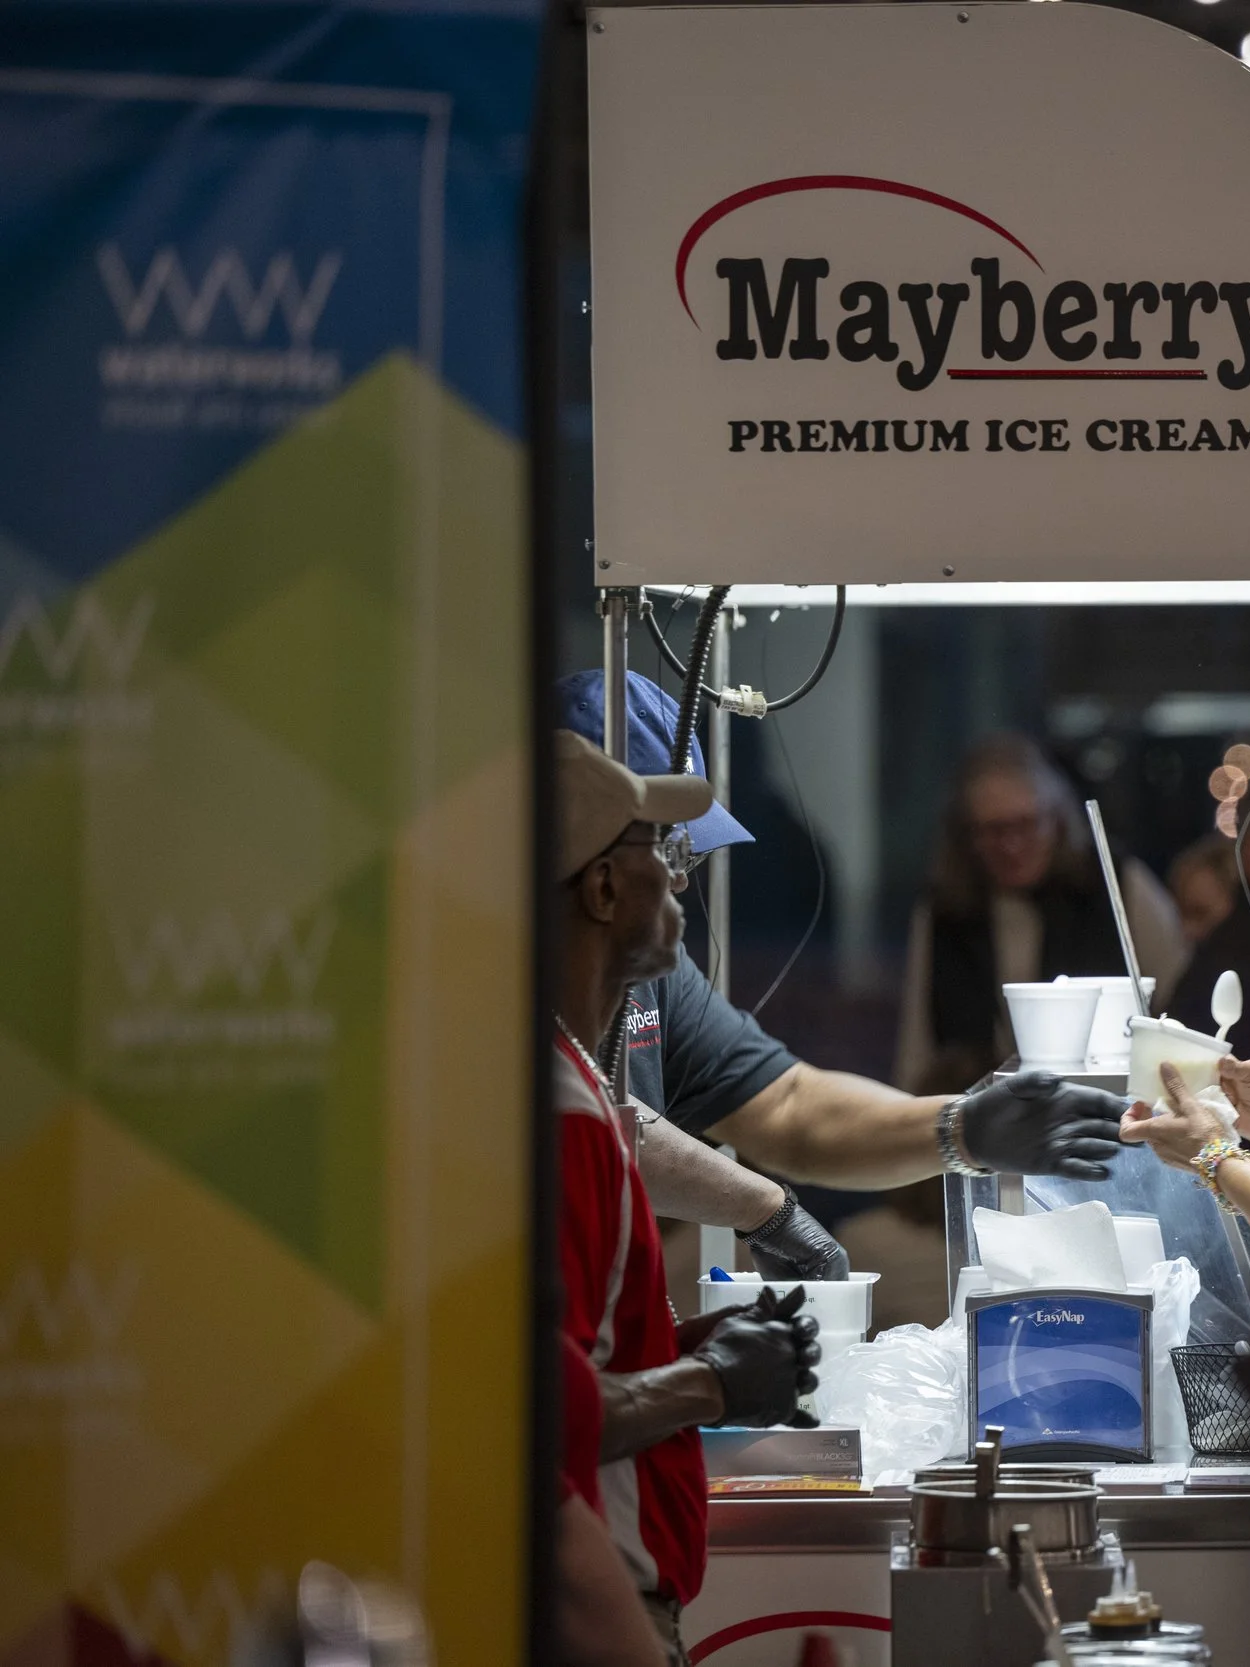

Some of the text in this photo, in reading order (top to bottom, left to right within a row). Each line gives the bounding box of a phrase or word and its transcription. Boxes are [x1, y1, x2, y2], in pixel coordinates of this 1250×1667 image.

[728, 419, 969, 452] PREMIUM
[985, 419, 1070, 452] ICE
[1036, 1310, 1085, 1325] EasyNap
